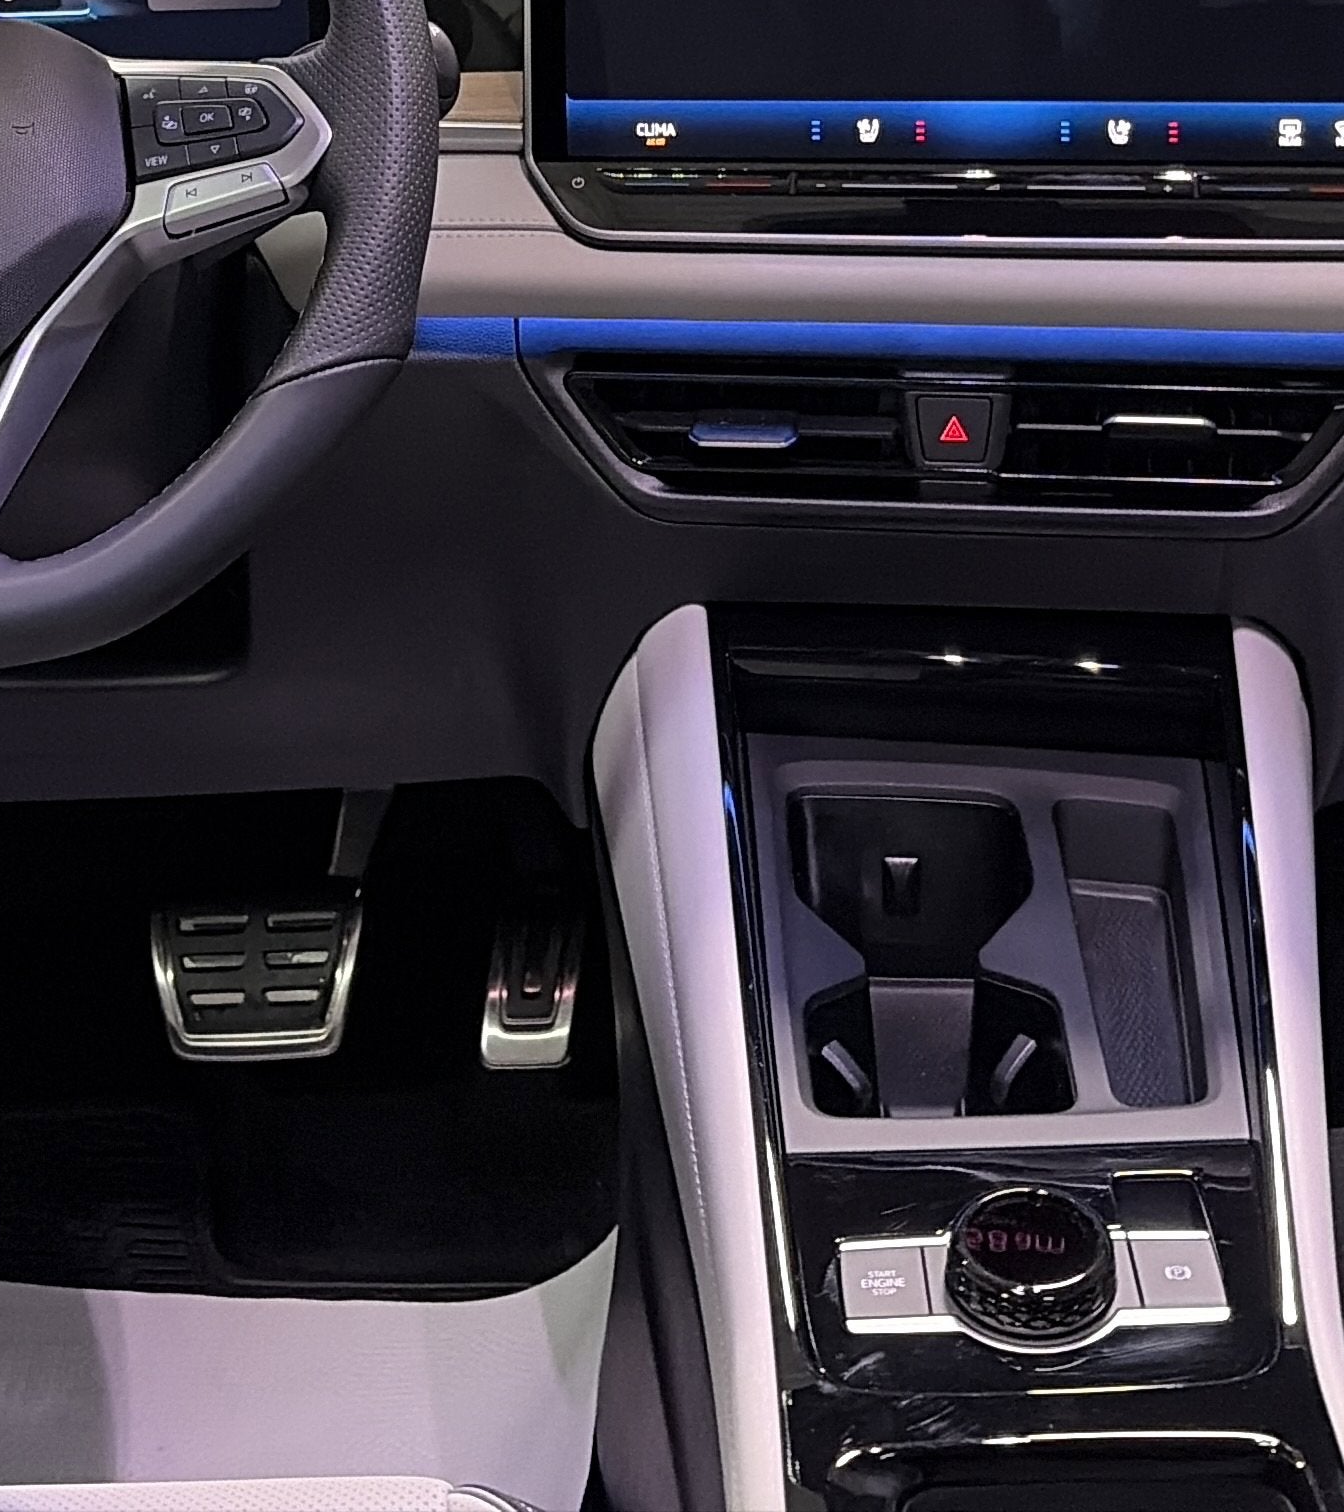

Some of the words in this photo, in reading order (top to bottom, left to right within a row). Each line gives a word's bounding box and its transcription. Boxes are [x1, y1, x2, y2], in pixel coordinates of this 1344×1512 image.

[199, 113, 215, 123] OK
[636, 122, 677, 137] CLIMA
[145, 156, 168, 168] VIEW
[867, 1270, 896, 1278] START
[860, 1277, 906, 1288] ENGINE
[871, 1288, 897, 1296] STOP
